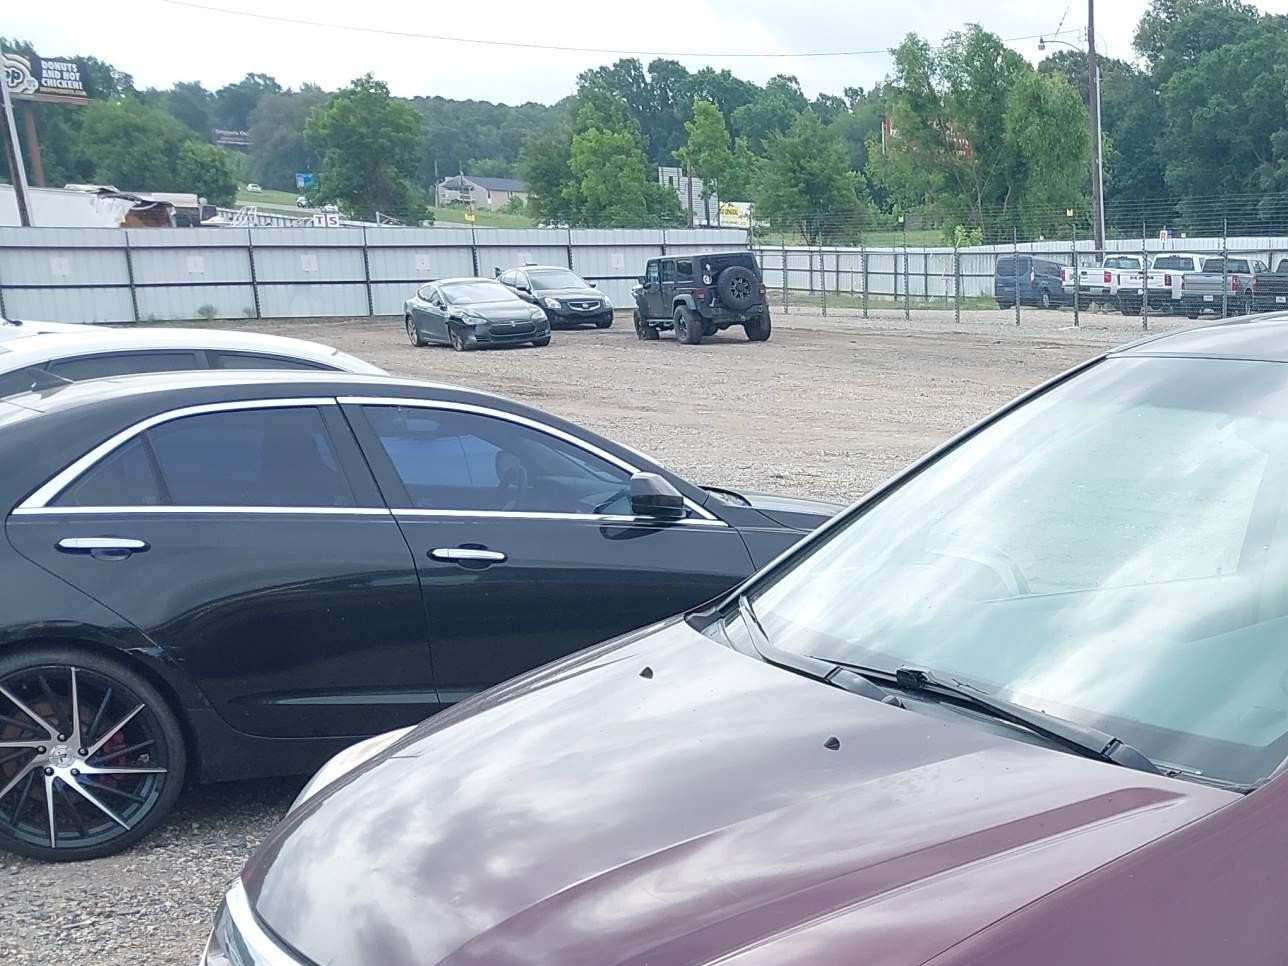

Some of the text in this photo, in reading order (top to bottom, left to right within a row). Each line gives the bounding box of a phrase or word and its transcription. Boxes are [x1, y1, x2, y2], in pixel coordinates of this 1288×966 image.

[41, 60, 78, 72] DONUTS
[41, 69, 80, 81] AND HOT
[41, 78, 83, 89] CHICKEN!
[315, 216, 337, 226] T S
